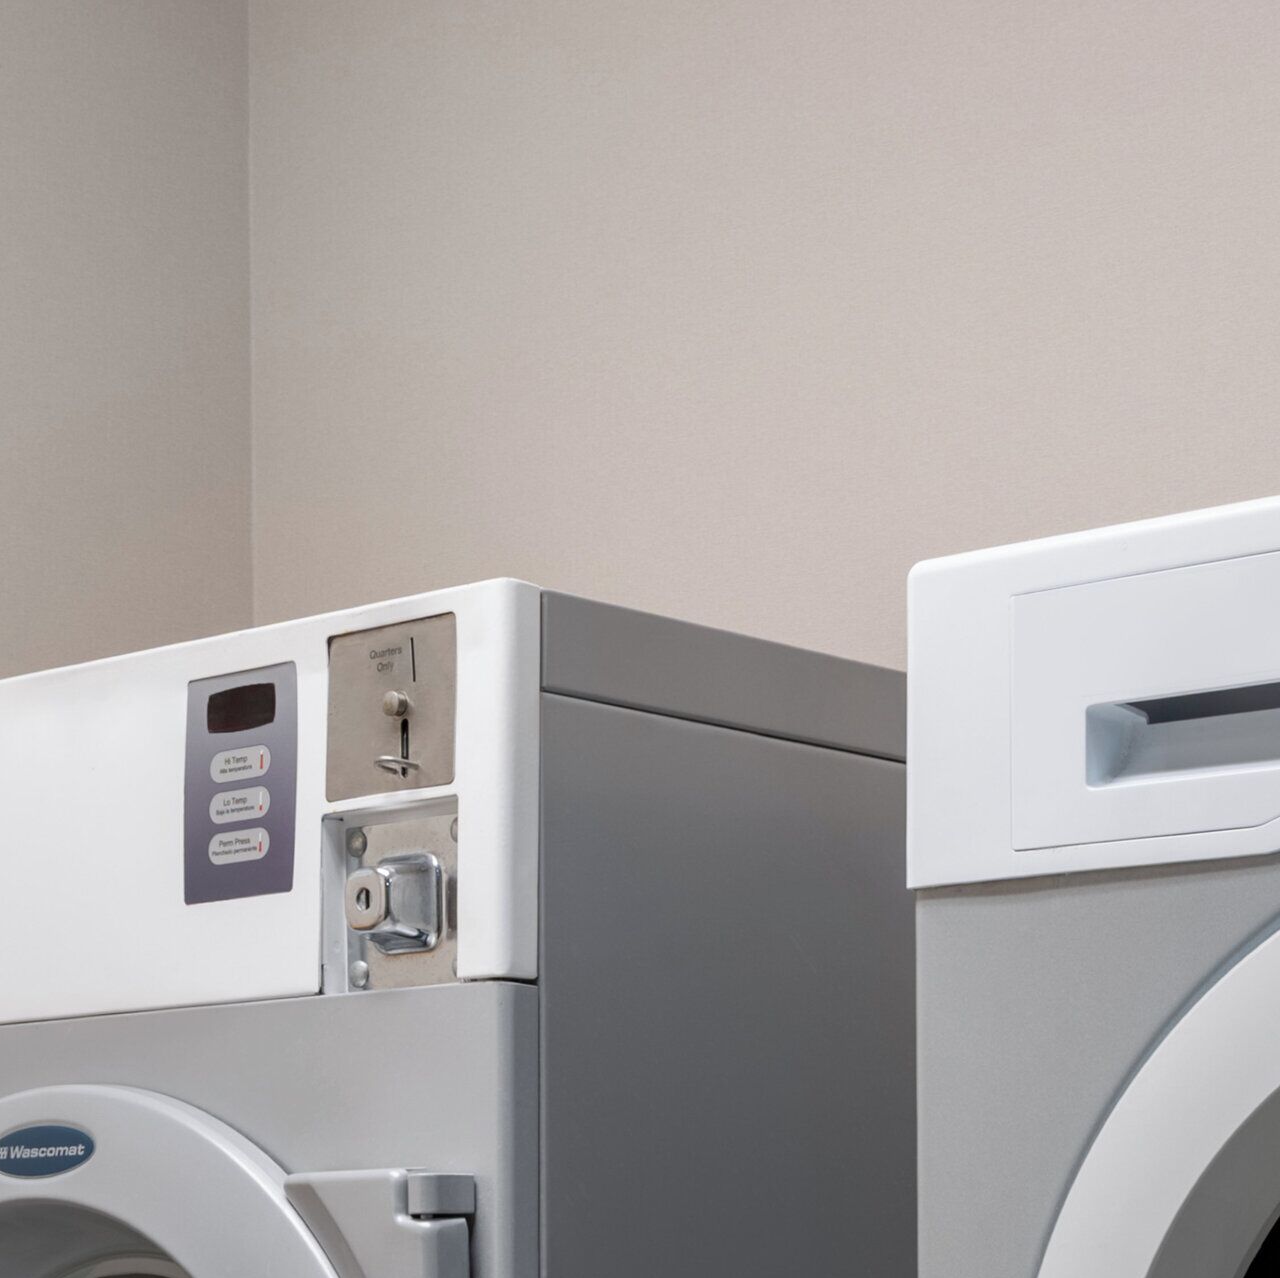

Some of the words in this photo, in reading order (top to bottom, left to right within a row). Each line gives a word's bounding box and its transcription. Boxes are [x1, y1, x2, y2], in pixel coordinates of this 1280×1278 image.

[370, 646, 402, 660] Quarters
[377, 661, 395, 672] Only
[231, 755, 248, 764] Temp
[223, 798, 231, 807] Lo
[231, 797, 248, 805] Temp
[9, 1143, 85, 1159] Wascomat
